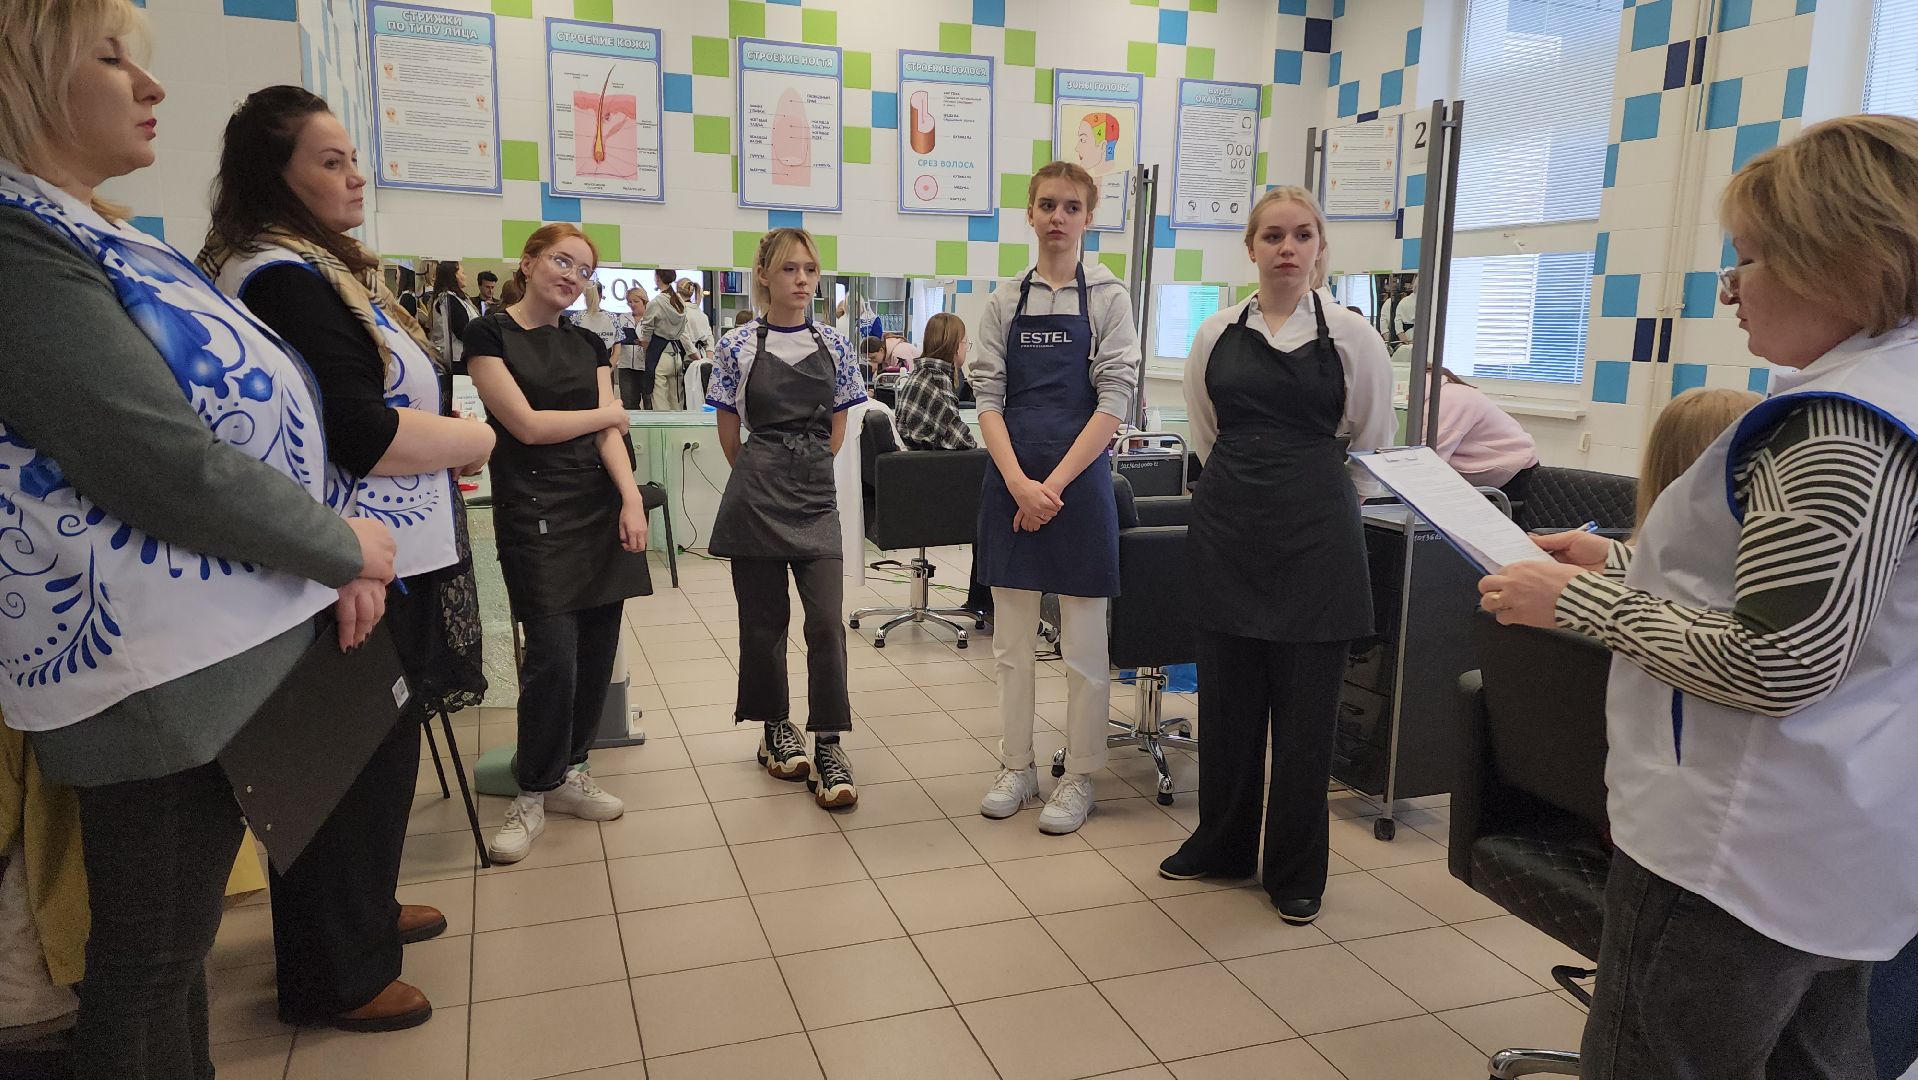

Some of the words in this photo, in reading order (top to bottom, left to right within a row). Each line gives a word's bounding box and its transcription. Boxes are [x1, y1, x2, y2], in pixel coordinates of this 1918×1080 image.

[402, 11, 463, 26] СТРИЖКИ
[387, 21, 406, 32] ПО
[409, 23, 441, 35] ТИПУ
[443, 27, 478, 40] ЛИЦА
[556, 32, 614, 47] СТРОЕНИЕ
[616, 38, 651, 51] КОЖИ
[747, 50, 799, 65] СТРОЕНИЕ
[801, 56, 833, 68] НОГТЯ
[905, 62, 950, 74] СТРОЕНИЕ
[952, 65, 987, 77] ВОЛОСА
[1066, 80, 1093, 90] ЗОНЫ
[1093, 82, 1130, 93] ГОЛОВЫ
[1415, 122, 1427, 149] 2
[917, 159, 938, 168] СРЕЗ
[940, 160, 975, 169] ВОЛОСА
[1130, 175, 1137, 196] 3
[1020, 331, 1073, 344] ESTEL
